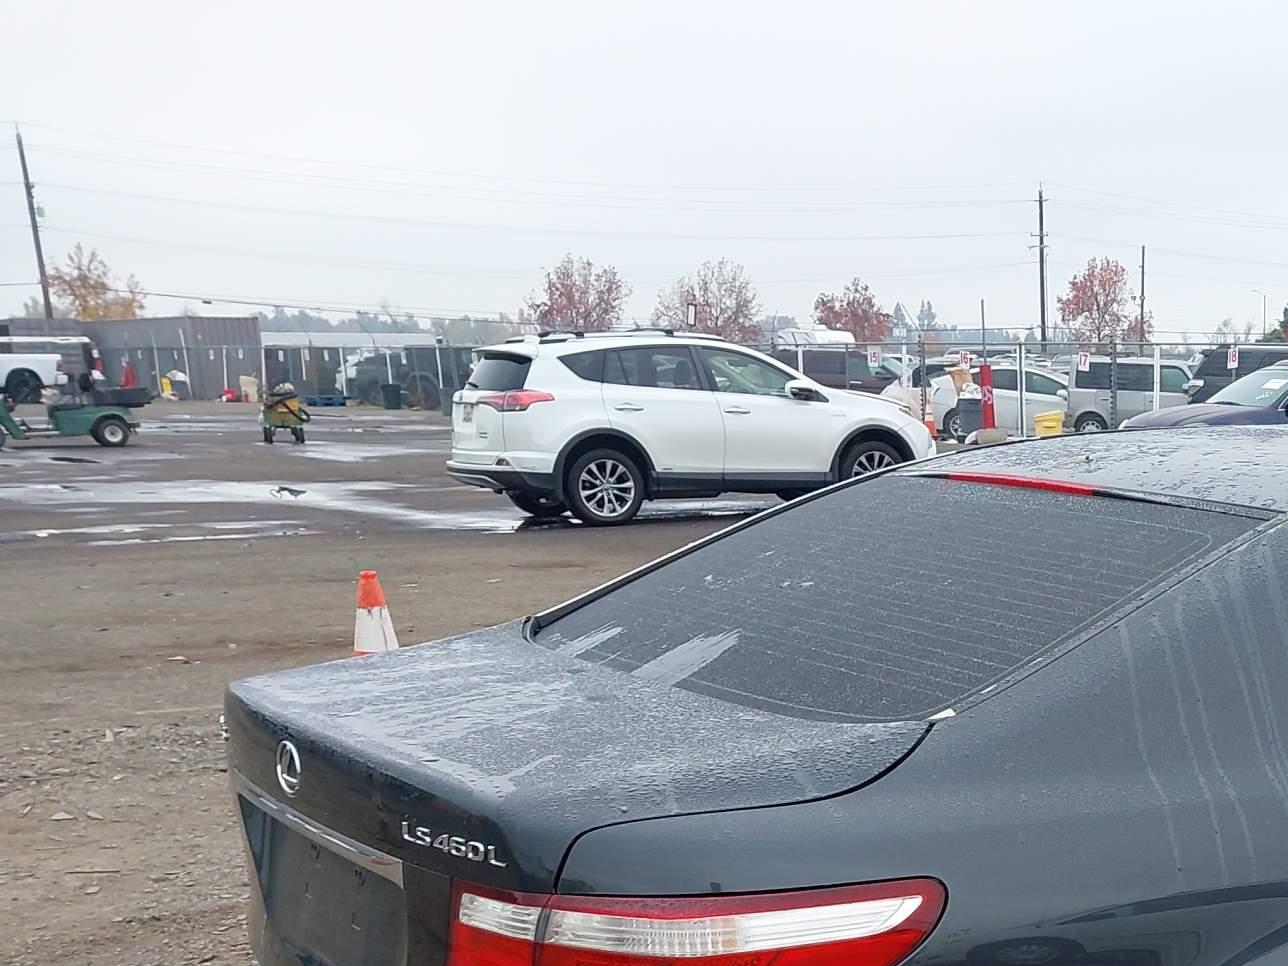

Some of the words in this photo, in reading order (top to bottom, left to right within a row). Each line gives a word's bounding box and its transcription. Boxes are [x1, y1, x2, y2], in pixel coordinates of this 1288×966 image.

[960, 352, 969, 365] 16
[1079, 353, 1089, 367] 17
[1229, 351, 1238, 363] 18
